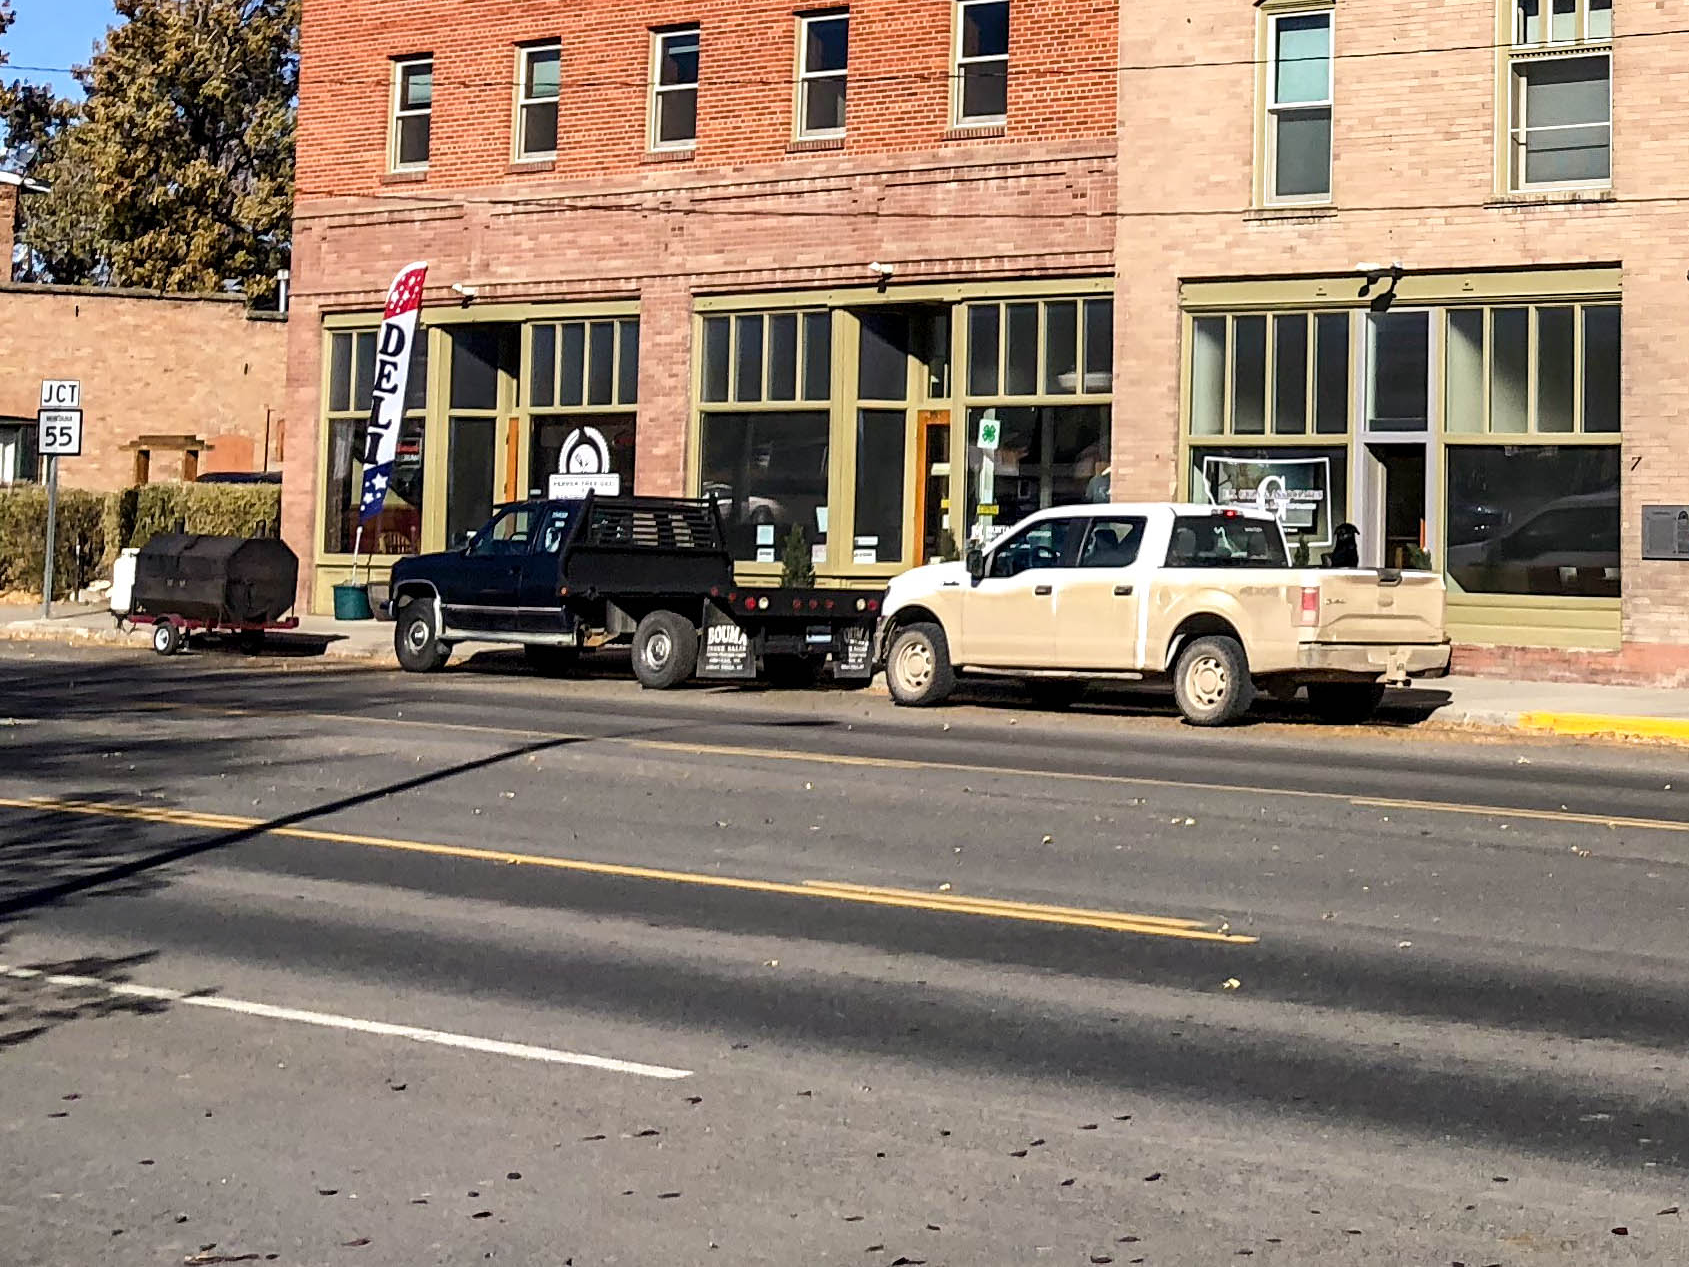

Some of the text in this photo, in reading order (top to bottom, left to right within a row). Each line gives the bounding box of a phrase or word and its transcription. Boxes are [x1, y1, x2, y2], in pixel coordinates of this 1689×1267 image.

[43, 384, 77, 403] JCT
[364, 322, 405, 464] DELI
[45, 426, 72, 446] 55
[707, 625, 748, 646] BOUMA
